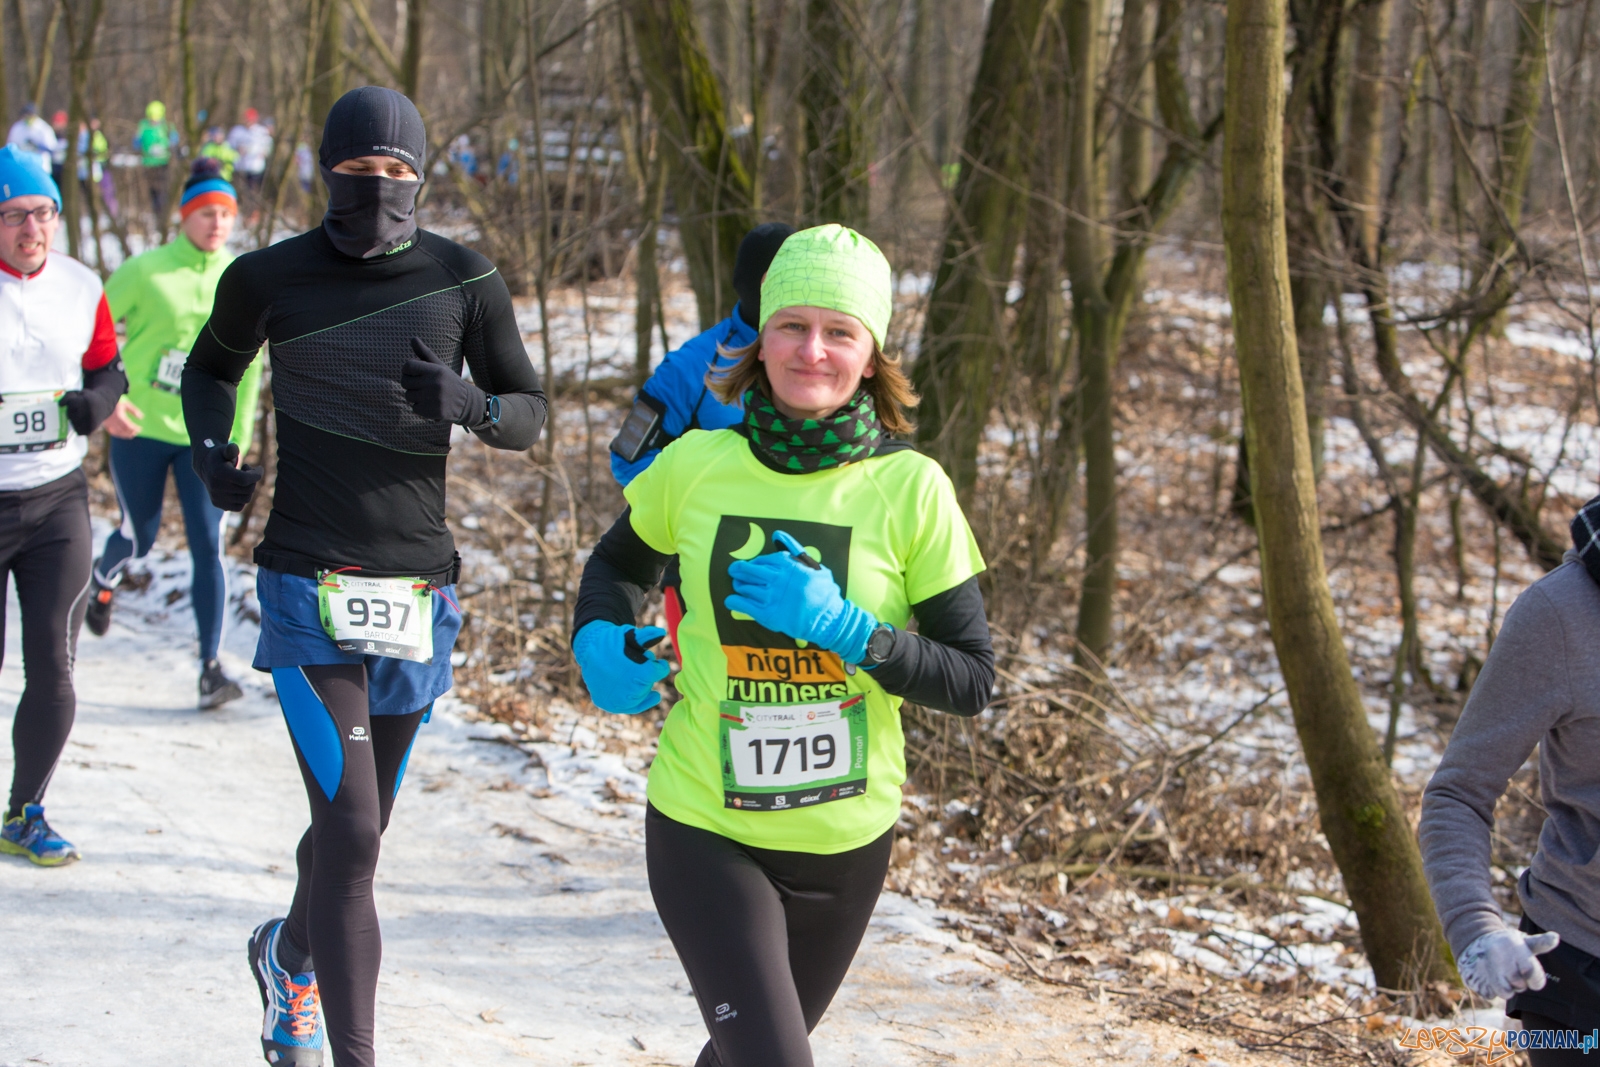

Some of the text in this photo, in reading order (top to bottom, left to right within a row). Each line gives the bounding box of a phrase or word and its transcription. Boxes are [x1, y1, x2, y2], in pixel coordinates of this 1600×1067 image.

[13, 411, 46, 433] 98
[347, 597, 411, 632] 937
[364, 631, 400, 642] BARTOSZ
[746, 648, 825, 681] night
[728, 678, 848, 703] runners
[748, 733, 836, 775] 1719
[854, 735, 864, 769] Poznań
